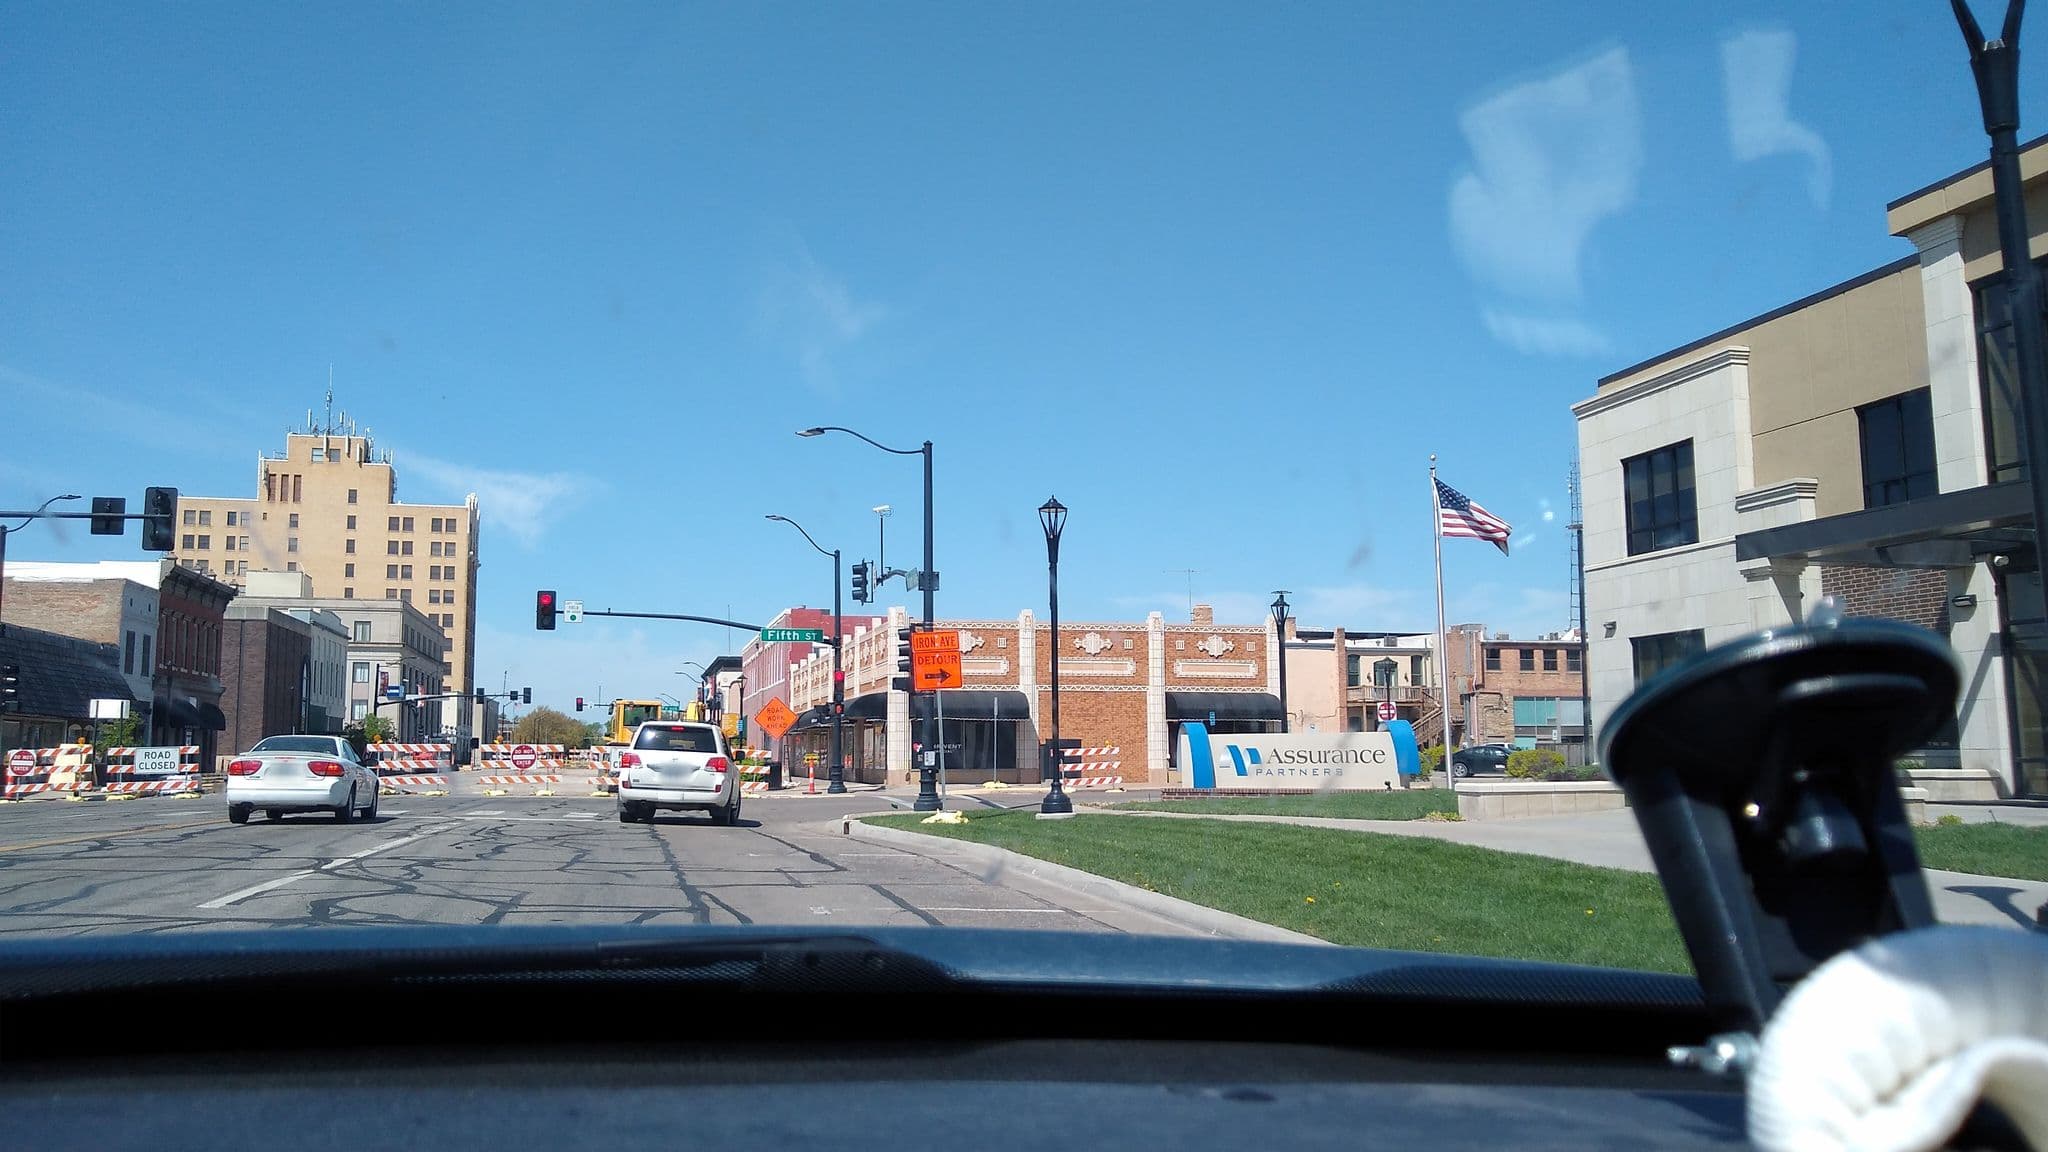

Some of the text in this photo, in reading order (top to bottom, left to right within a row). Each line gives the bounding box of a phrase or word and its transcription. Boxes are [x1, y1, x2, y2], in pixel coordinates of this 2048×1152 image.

[767, 630, 818, 641] Fifth ST
[915, 635, 957, 649] IRON AVE
[917, 654, 958, 666] DETOUR
[144, 751, 171, 760] ROAD
[1266, 748, 1386, 765] Assurance
[138, 761, 176, 770] CLOSED
[1256, 768, 1343, 776] PARTNERS
